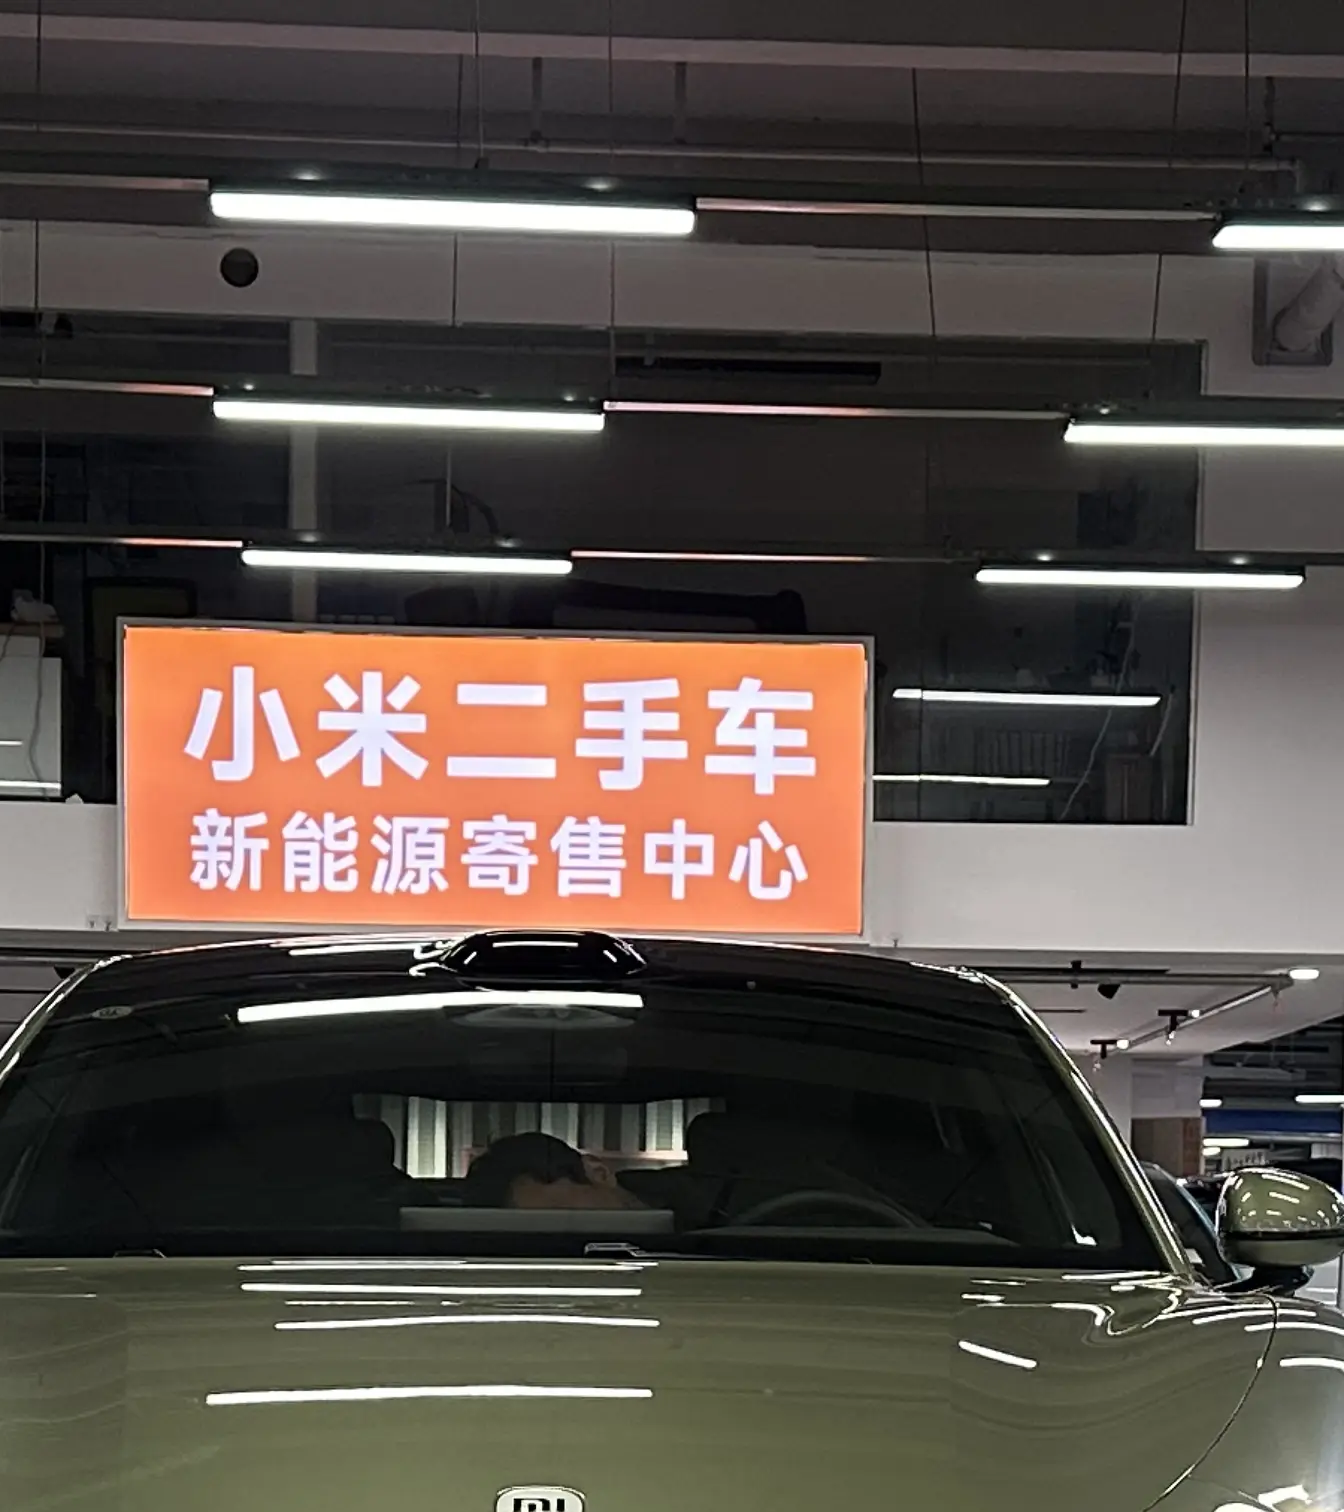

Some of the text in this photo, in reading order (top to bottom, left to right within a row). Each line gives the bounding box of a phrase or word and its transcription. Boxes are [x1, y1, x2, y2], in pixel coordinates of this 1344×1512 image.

[183, 665, 817, 796] 小米二手车
[190, 807, 808, 901] 新能源寄售中心
